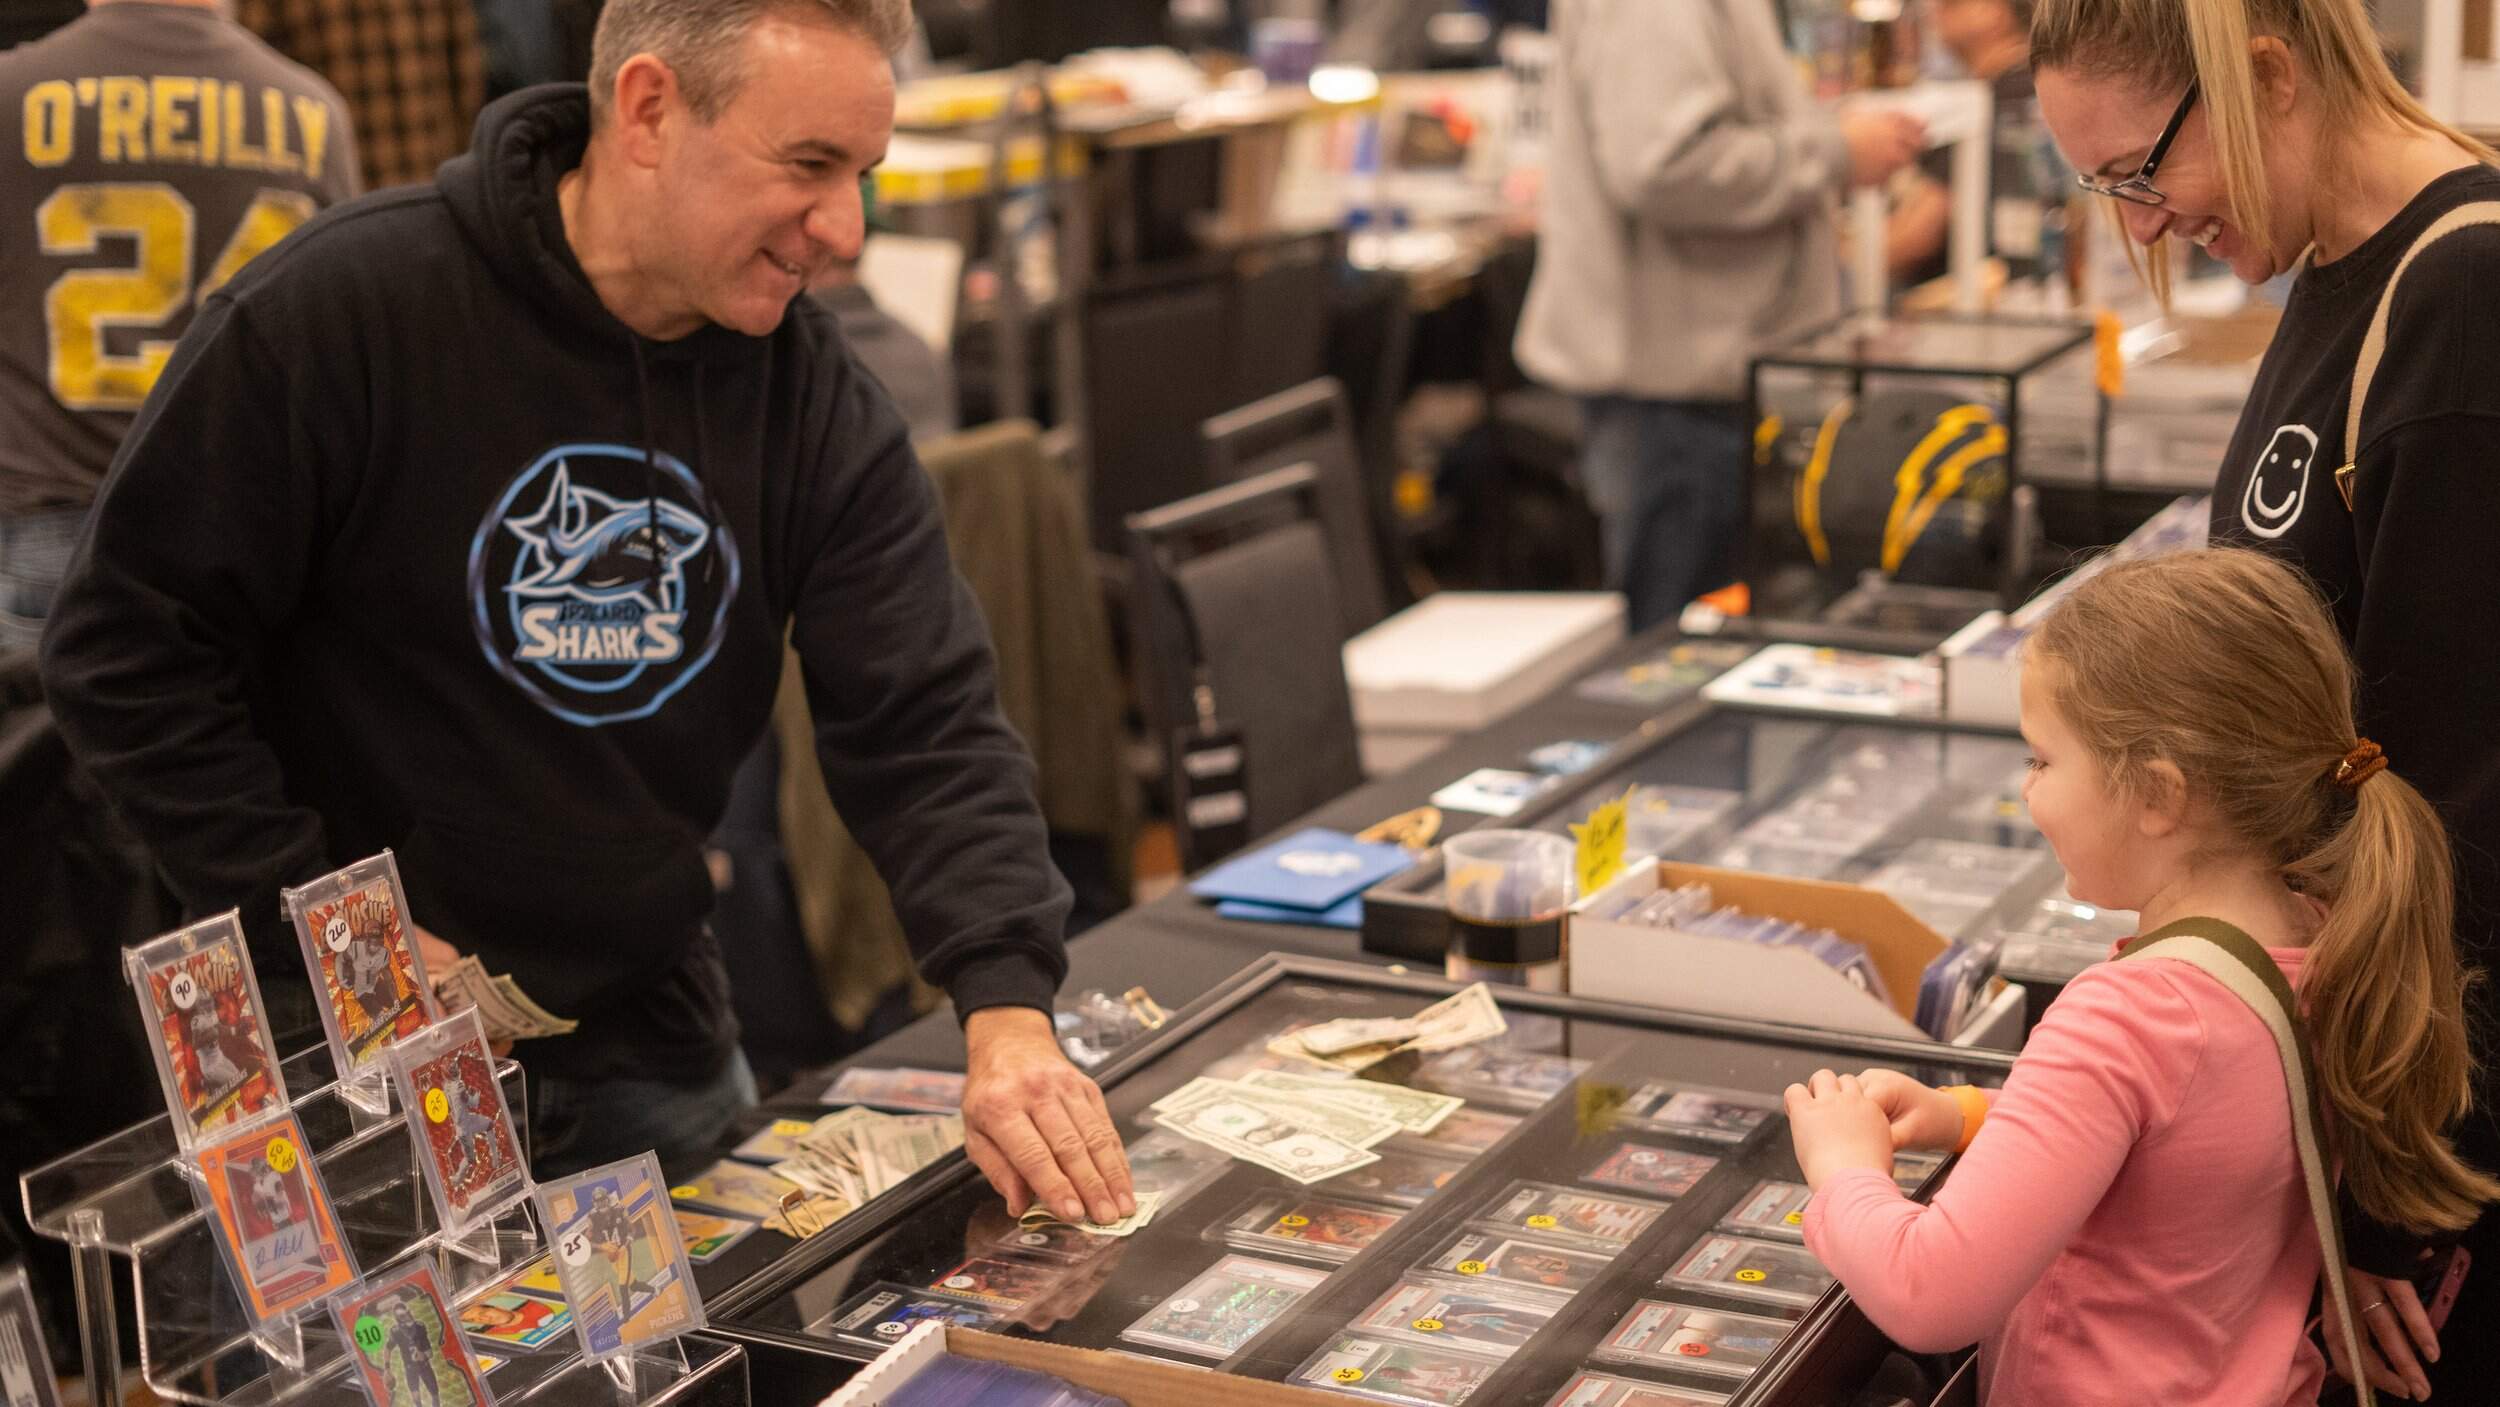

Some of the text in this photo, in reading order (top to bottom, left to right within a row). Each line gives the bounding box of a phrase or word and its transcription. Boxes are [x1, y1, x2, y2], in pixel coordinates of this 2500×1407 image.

[22, 75, 329, 181] O'REILLY
[519, 606, 682, 660] SHARKS
[175, 979, 191, 1001] 90
[564, 1234, 582, 1256] 25
[355, 1324, 381, 1346] $10
